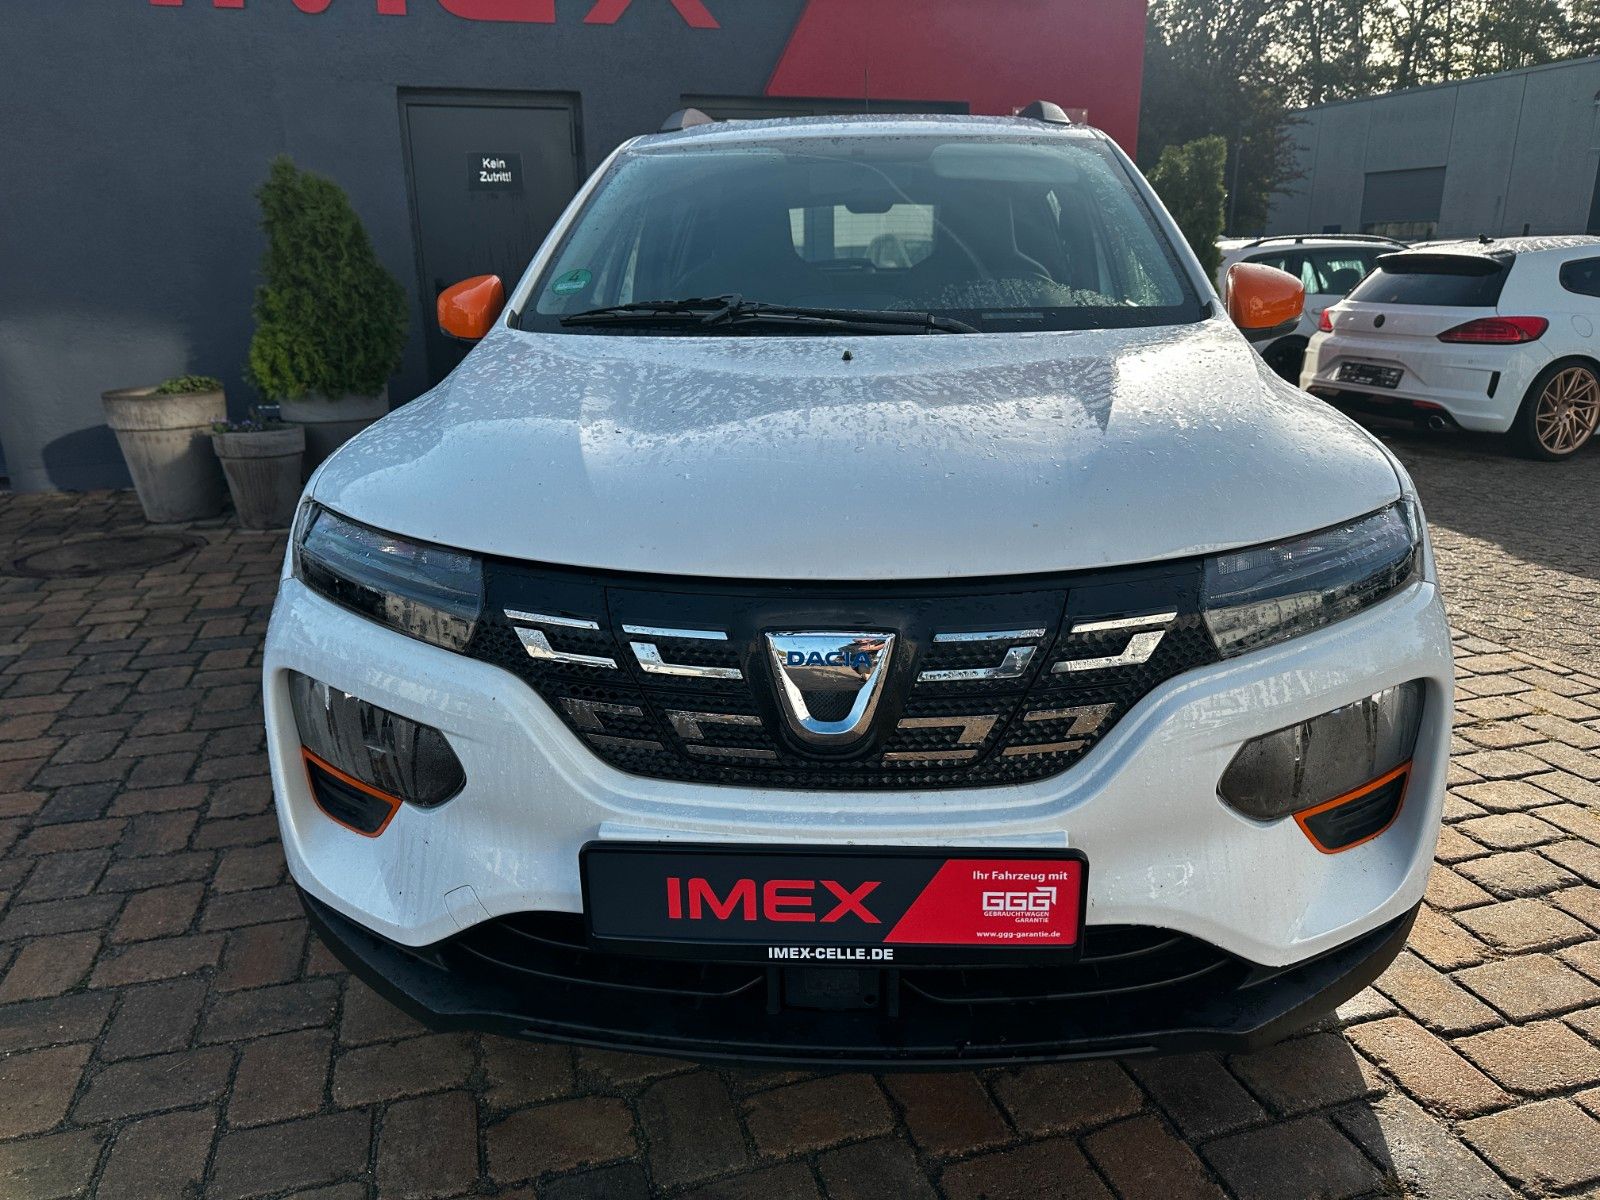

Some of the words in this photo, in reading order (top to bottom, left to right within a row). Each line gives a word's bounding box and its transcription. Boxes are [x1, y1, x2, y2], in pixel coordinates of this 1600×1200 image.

[482, 158, 505, 168] Kein
[480, 171, 511, 181] Zutritt!
[787, 651, 872, 667] DACIA
[973, 871, 989, 880] Ihr
[992, 871, 1045, 882] Fahrzeug
[1048, 872, 1067, 880] mit
[667, 877, 882, 924] IMEX
[982, 891, 1050, 911] GGG
[768, 947, 894, 961] IMEX-CELLE.DE
